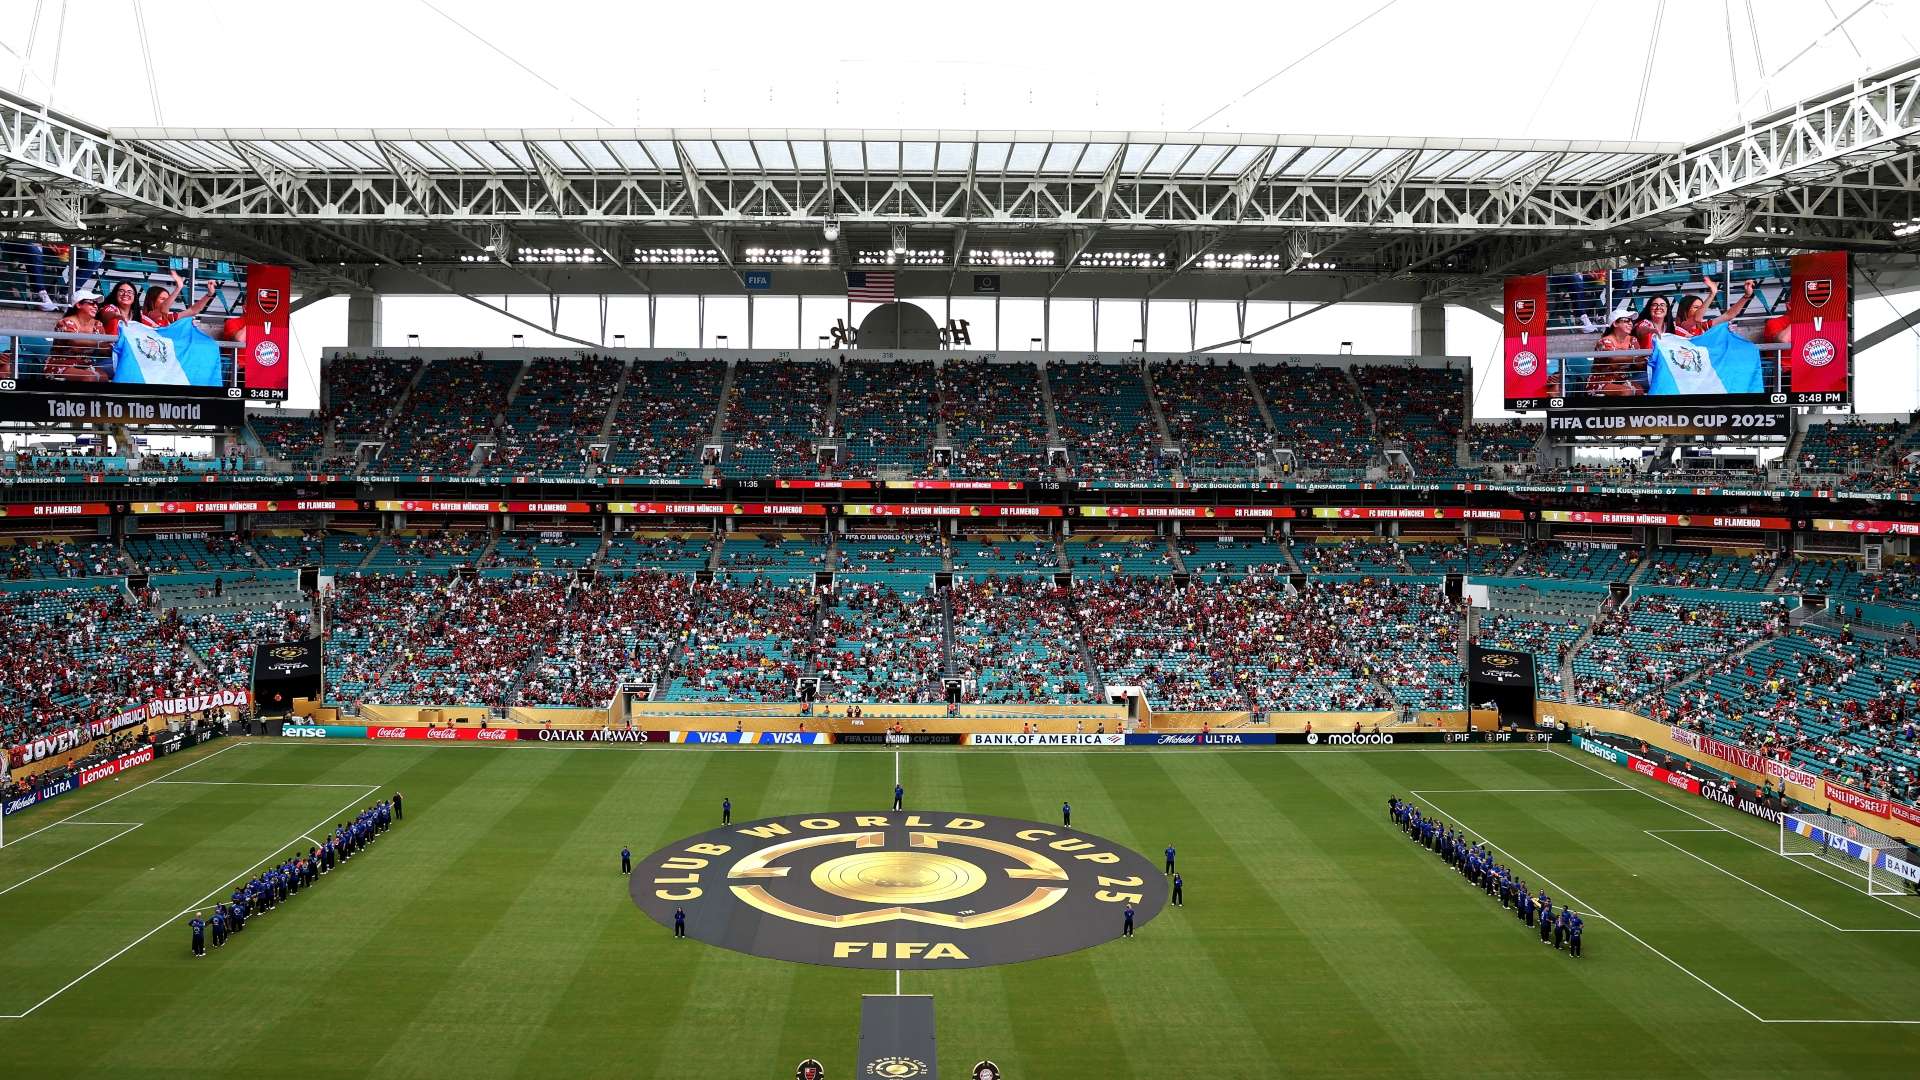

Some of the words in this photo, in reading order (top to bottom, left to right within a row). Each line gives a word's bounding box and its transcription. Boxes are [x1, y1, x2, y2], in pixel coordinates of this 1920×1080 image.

[748, 276, 766, 284] FIFA
[1814, 318, 1822, 331] V
[1, 381, 14, 389] CC
[251, 390, 269, 398] 3:48
[272, 390, 284, 398] PM
[1772, 394, 1786, 403] CC
[1799, 394, 1821, 403] 3:48
[1826, 394, 1840, 402] PM
[1533, 399, 1538, 407] F
[1552, 399, 1562, 407] CC
[48, 400, 85, 418] Take
[90, 400, 101, 418] It
[106, 401, 122, 418] To
[128, 402, 154, 418] The
[160, 403, 200, 420] World
[1551, 417, 1582, 430] FIFA
[1586, 416, 1626, 429] CLUB
[1630, 415, 1692, 428] WORLD
[1694, 414, 1728, 428] CUP
[1882, 492, 1891, 500] 73
[34, 506, 44, 514] CR
[46, 506, 82, 514] FLAMENGO
[196, 502, 204, 511] FC
[206, 502, 228, 511] BAYERN
[229, 502, 258, 511] MÜNCHEN
[432, 502, 440, 511] FC
[441, 502, 460, 511] BAYERN
[666, 504, 672, 513] FC
[674, 504, 694, 513] BAYERN
[902, 506, 909, 514] FC
[911, 506, 932, 514] BAYERN
[1138, 508, 1144, 516] FC
[1146, 508, 1166, 516] BAYERN
[1168, 508, 1196, 516] MÜNCHEN
[1369, 509, 1376, 517] FC
[1378, 509, 1398, 517] BAYERN
[1399, 509, 1424, 517] MÜNCHEN
[1464, 510, 1471, 518] CR
[1472, 510, 1500, 518] FLAMENGO
[1603, 512, 1610, 524] FC
[1611, 512, 1635, 524] BAYERN
[1636, 512, 1666, 524] MÜNCHEN
[1714, 518, 1723, 528] CR
[1724, 518, 1760, 528] FLAMENGO
[1892, 524, 1900, 533] FC
[1901, 524, 1919, 533] BAYERN
[150, 690, 247, 717] URUBUZADA
[202, 730, 212, 741] PIF
[377, 728, 408, 738] Coca-Cola
[427, 728, 457, 739] Coca-Cola
[478, 729, 507, 740] Coca-Cola
[538, 730, 584, 742] QATAR
[591, 730, 648, 742] AIRWAYS
[697, 732, 728, 743] VISA
[772, 732, 802, 743] VISA
[1328, 732, 1393, 744] motorola
[1455, 733, 1470, 741] PIF
[1496, 733, 1511, 741] PIF
[1538, 733, 1552, 741] PIF
[975, 735, 1014, 744] BANK
[1018, 735, 1036, 744] OF
[1038, 735, 1102, 744] AMERICA
[1158, 734, 1194, 744] Michelob
[1206, 735, 1241, 744] ULTRA
[170, 740, 182, 750] PIF
[1580, 738, 1616, 763] Hisense
[118, 752, 151, 771] Lenovo
[82, 764, 115, 784] Lenovo
[1636, 762, 1655, 776] Coca-Cola
[1768, 761, 1782, 778] RED
[1784, 768, 1814, 789] POWER
[1668, 773, 1688, 790] Coca-Cola
[6, 795, 36, 814] Michelob
[44, 780, 71, 798] ULTRA
[1702, 786, 1734, 807] QATAR
[1738, 799, 1782, 826] AIRWAYS
[736, 816, 986, 840] WORLD
[1016, 829, 1121, 864] CUP
[654, 842, 732, 900] CLUB
[1888, 860, 1916, 878] BANK
[833, 942, 970, 959] FIFA
